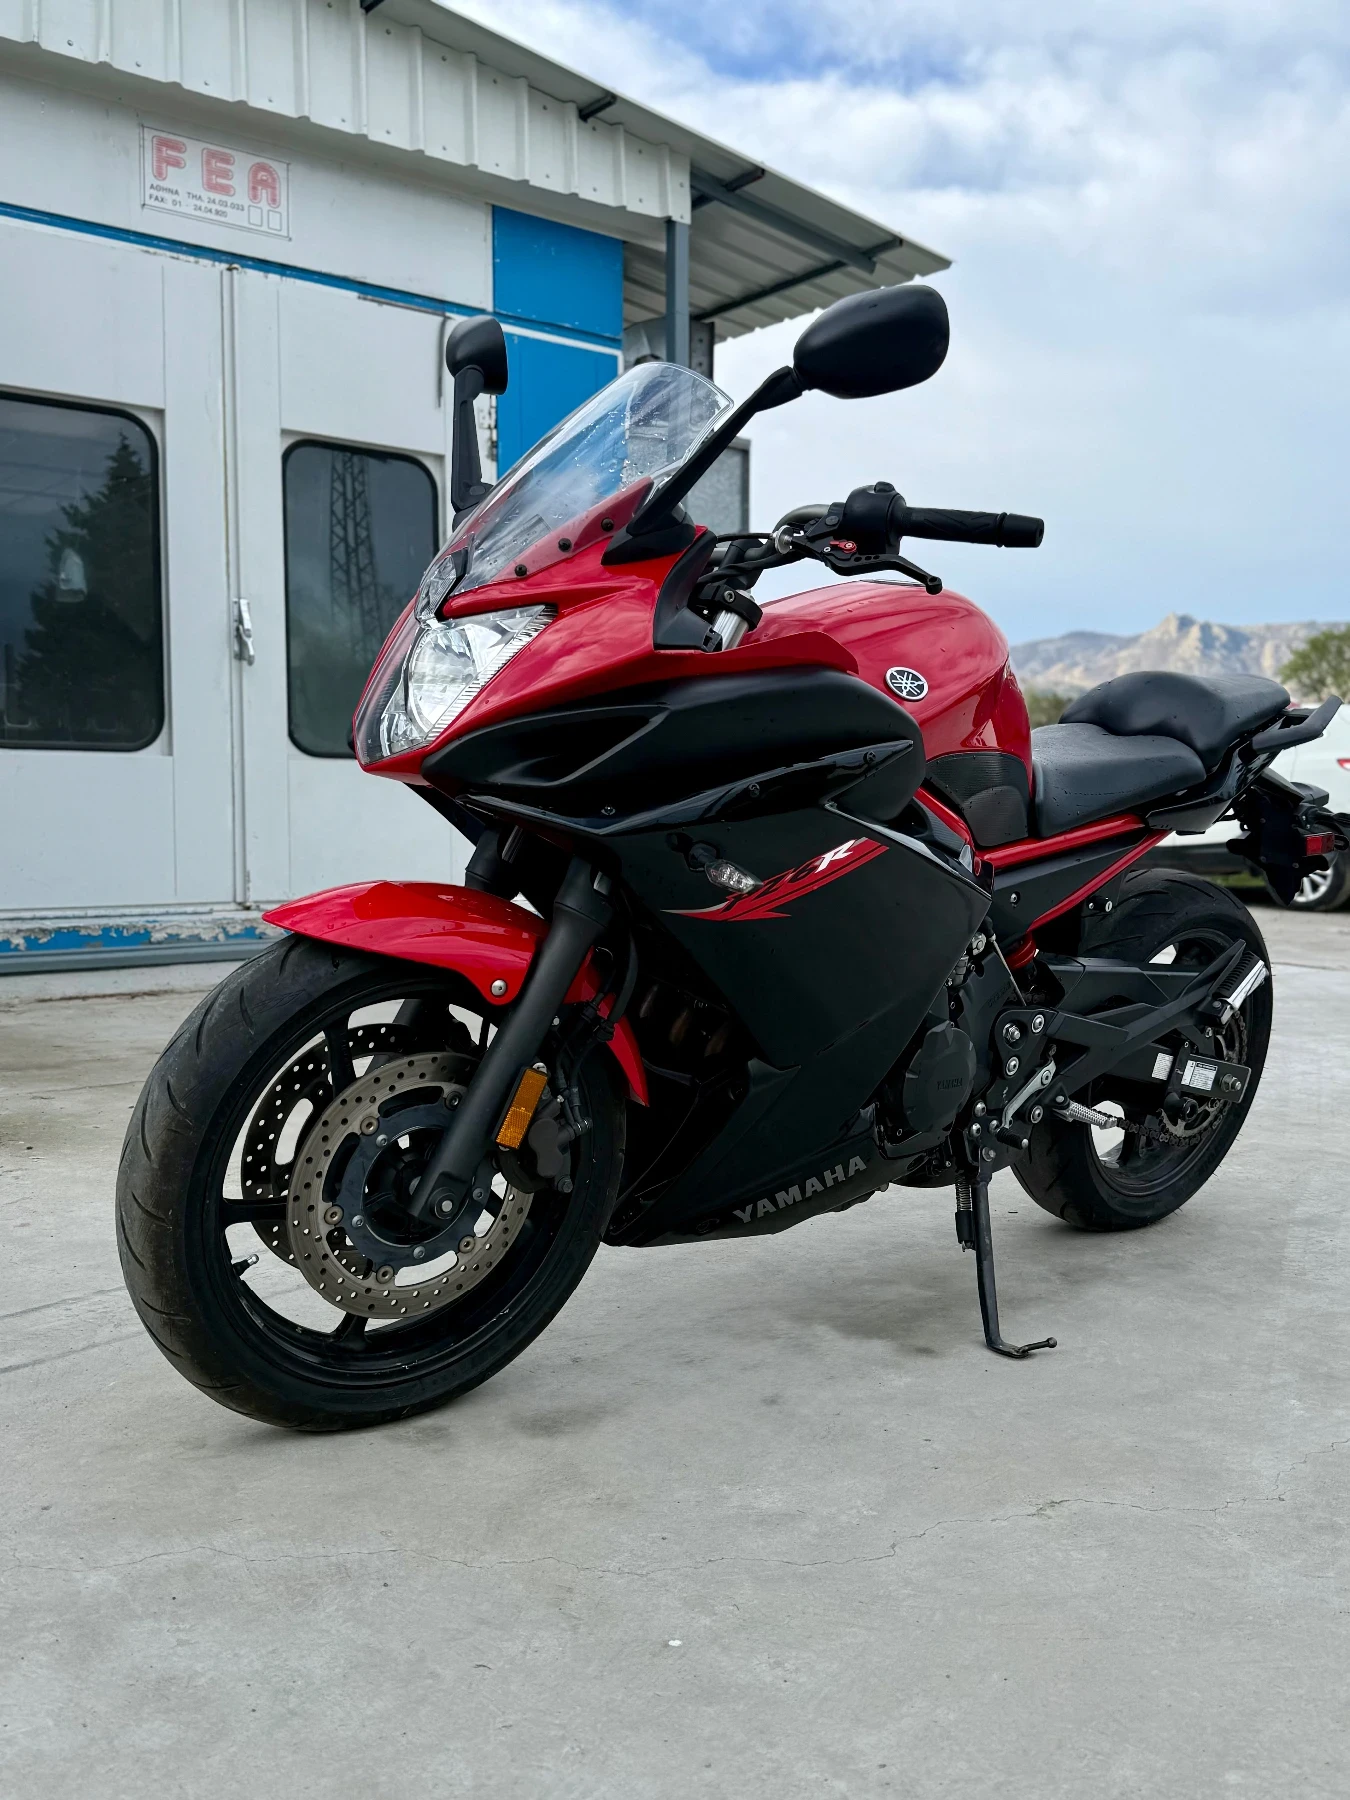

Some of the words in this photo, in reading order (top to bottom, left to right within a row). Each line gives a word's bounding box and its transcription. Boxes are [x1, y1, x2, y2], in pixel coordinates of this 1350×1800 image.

[149, 193, 168, 204] FAX:
[172, 198, 182, 208] 01
[152, 135, 281, 209] FEA
[732, 1155, 867, 1224] YAMAHA
